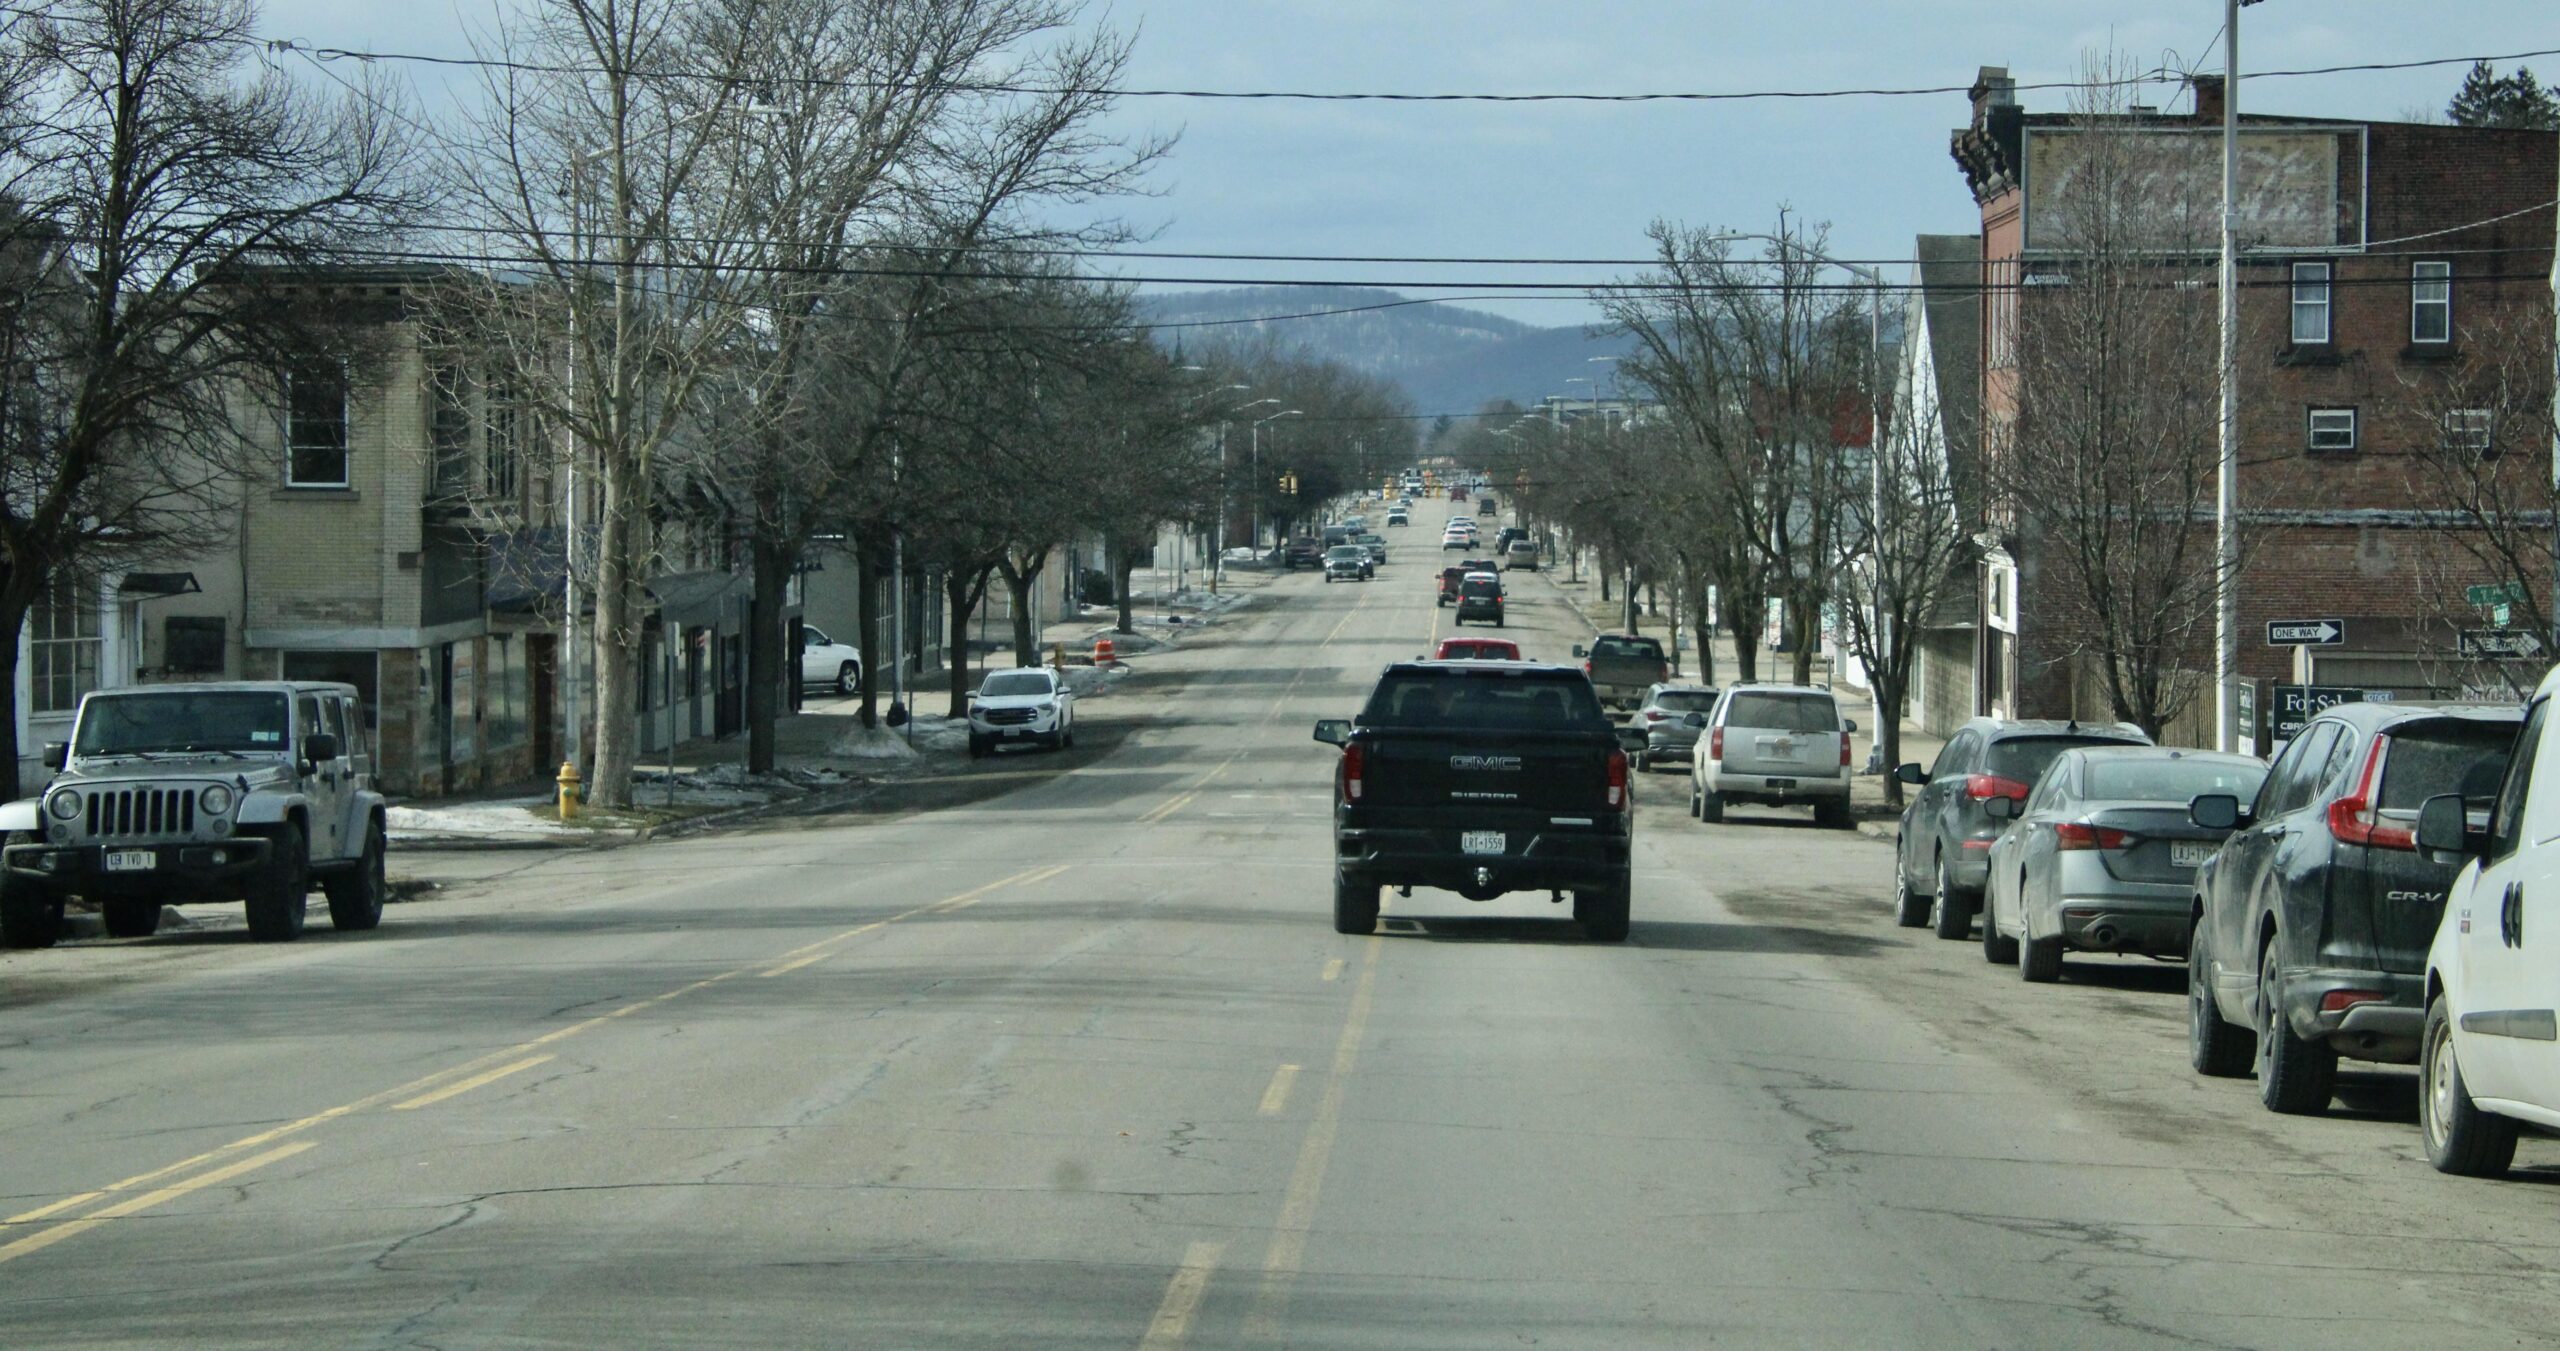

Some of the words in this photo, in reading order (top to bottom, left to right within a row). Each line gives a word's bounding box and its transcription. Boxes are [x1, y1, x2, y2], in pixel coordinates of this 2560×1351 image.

[2275, 628, 2295, 638] ONE
[2299, 627, 2320, 637] WAY
[1451, 756, 1521, 770] GMC
[2387, 891, 2442, 901] CR-V
